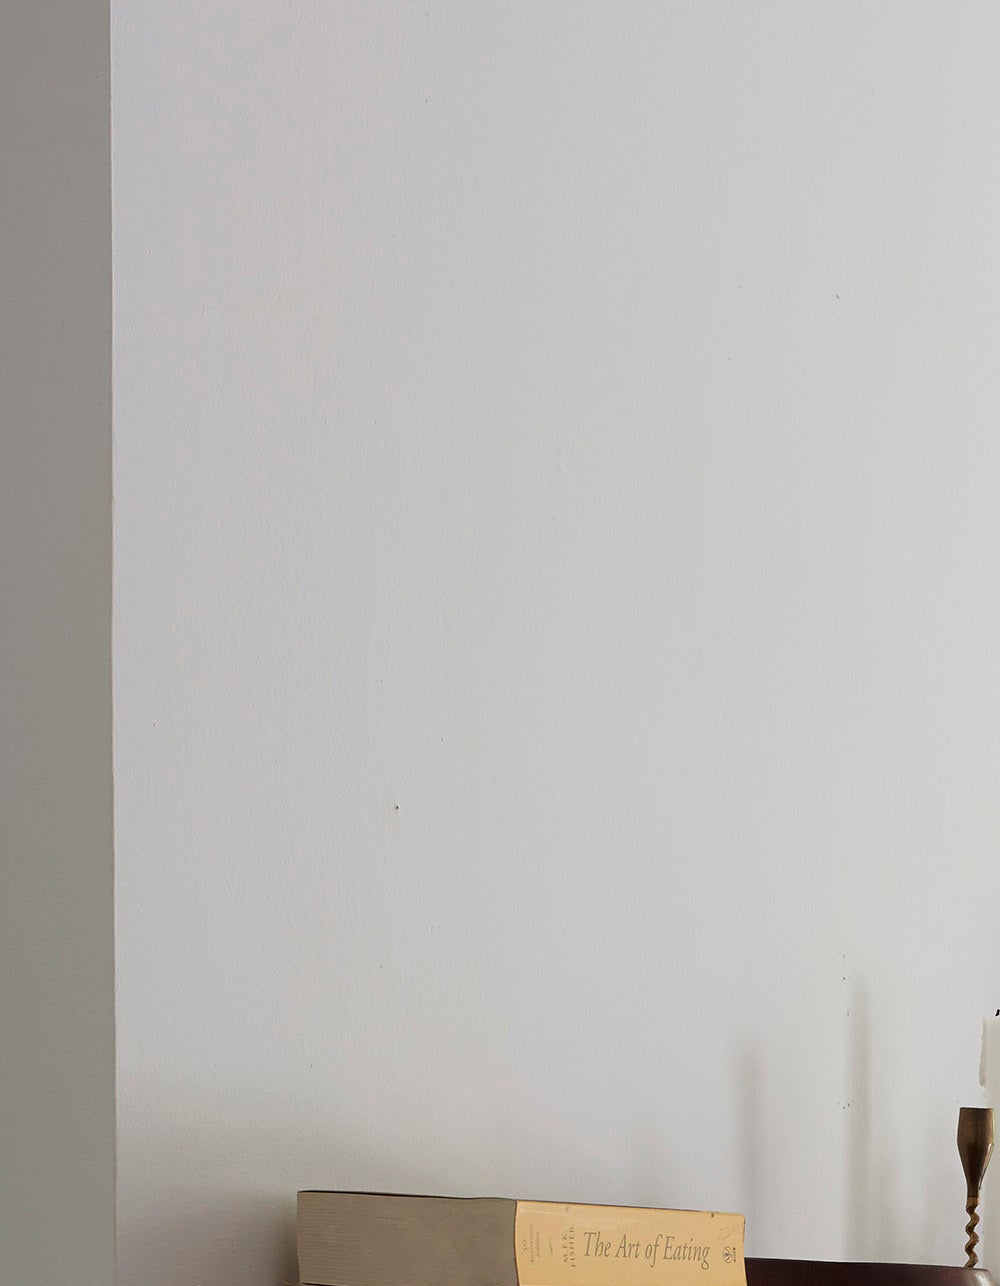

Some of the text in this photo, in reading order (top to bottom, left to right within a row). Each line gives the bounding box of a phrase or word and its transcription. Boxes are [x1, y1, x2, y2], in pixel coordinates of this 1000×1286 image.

[568, 1226, 576, 1268] FISHER
[583, 1231, 612, 1257] The
[614, 1233, 641, 1258] Art
[645, 1233, 663, 1268] of
[663, 1235, 711, 1270] Eating
